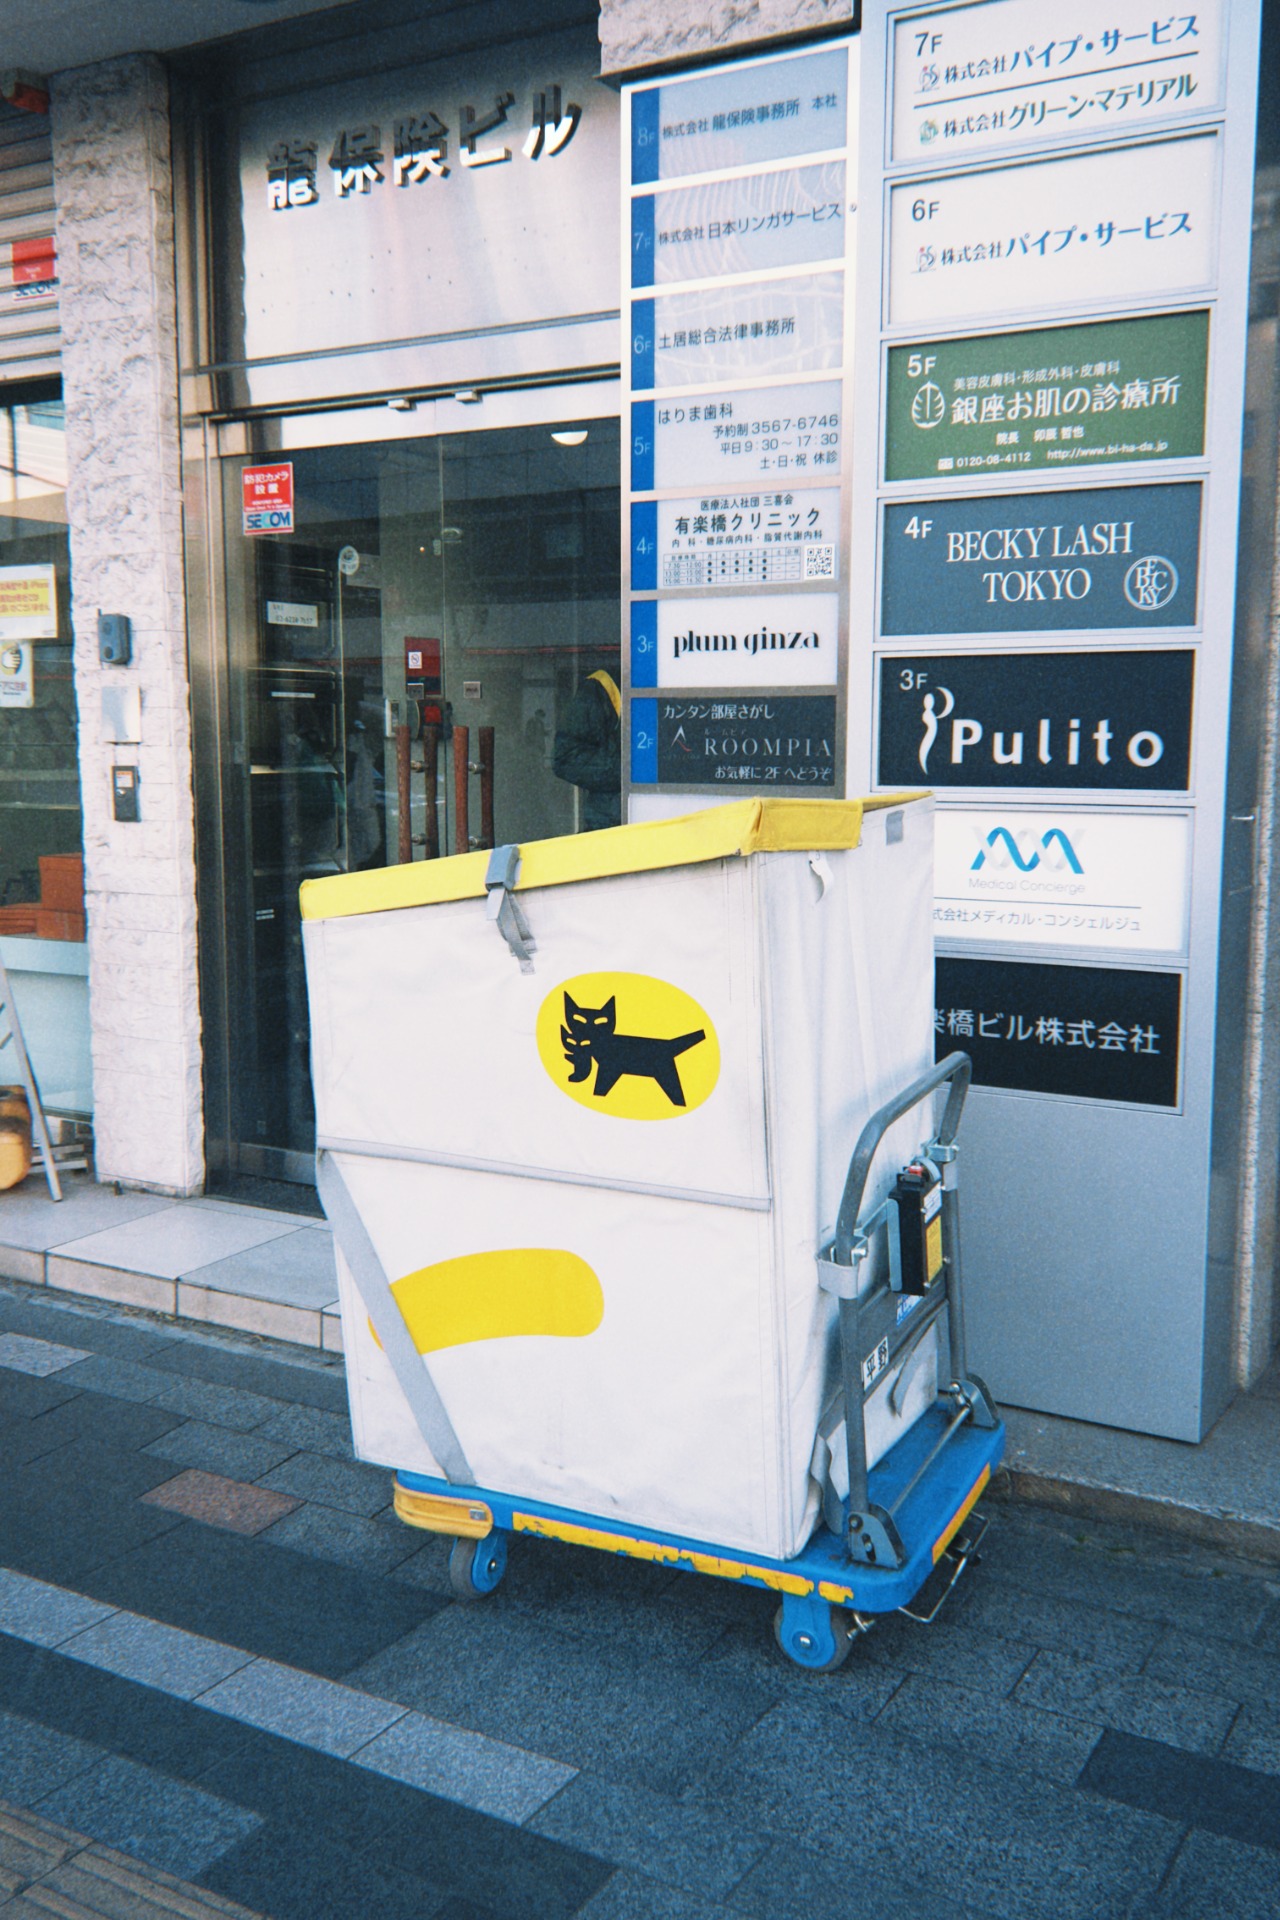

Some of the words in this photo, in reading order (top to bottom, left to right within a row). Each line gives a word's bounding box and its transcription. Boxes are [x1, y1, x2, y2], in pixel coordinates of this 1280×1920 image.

[914, 32, 943, 56] 7F
[811, 92, 838, 110] 本社
[911, 199, 941, 222] 6F
[633, 334, 652, 355] 6F
[657, 316, 796, 350] 土居総合法律事務所
[907, 353, 937, 377] 5F
[951, 374, 1182, 425] 銀座お肌の診療所
[657, 401, 734, 425] はりま歯科
[634, 436, 652, 456] 5F
[246, 511, 291, 529] SECOM
[674, 507, 820, 535] 有楽橋クリニック
[904, 516, 933, 540] 4F
[636, 536, 654, 556] 4F
[946, 526, 1047, 563] BECKY
[1051, 521, 1135, 557] LASH
[982, 567, 1092, 604] TOKYO
[636, 635, 654, 654] 3F
[673, 629, 738, 659] plum
[743, 626, 820, 656] ginza
[899, 668, 928, 691] 3F
[663, 704, 775, 720] カンタン部屋さがし
[636, 731, 654, 749] 2F
[704, 737, 832, 757] ROOMPIA
[951, 718, 1164, 768] Pulito
[968, 877, 1017, 890] Medical
[1019, 879, 1086, 896] Concierge
